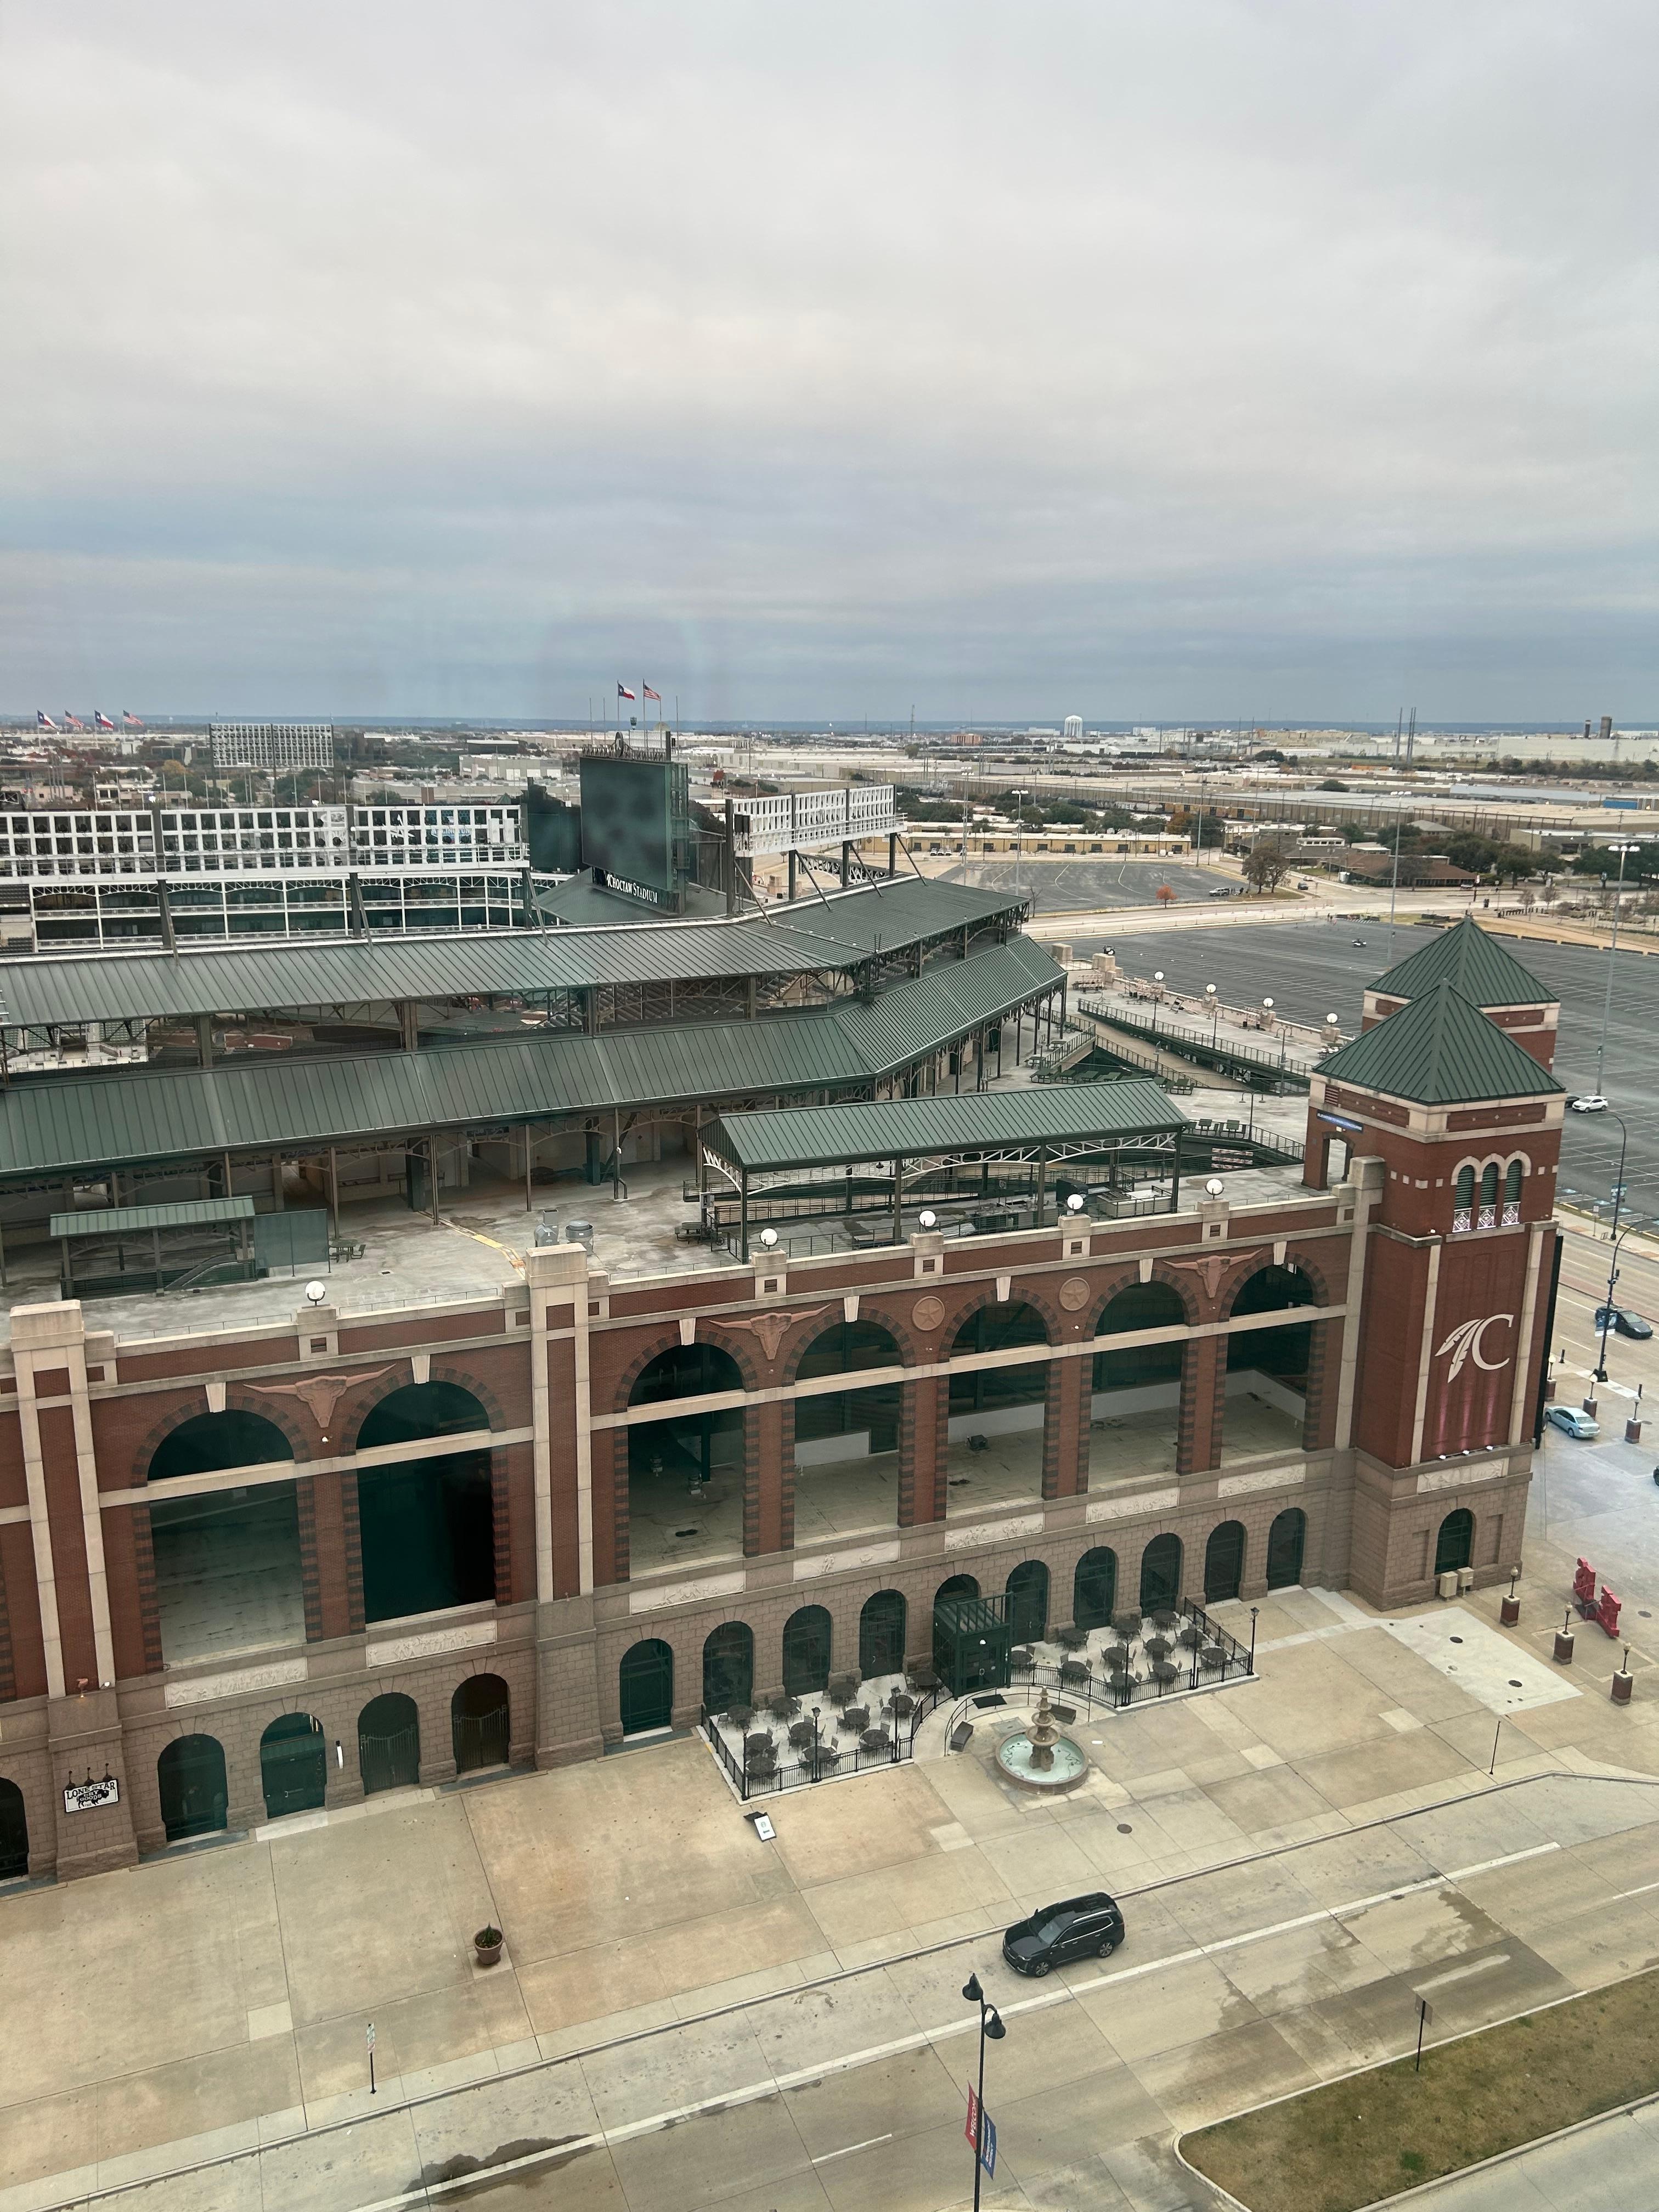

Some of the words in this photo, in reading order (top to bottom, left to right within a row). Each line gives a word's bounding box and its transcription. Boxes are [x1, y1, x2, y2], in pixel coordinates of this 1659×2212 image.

[609, 874, 633, 894] CHOCTAW
[633, 882, 658, 904] STADIUM
[66, 1787, 90, 1799] LONE
[92, 1781, 115, 1790] STAR
